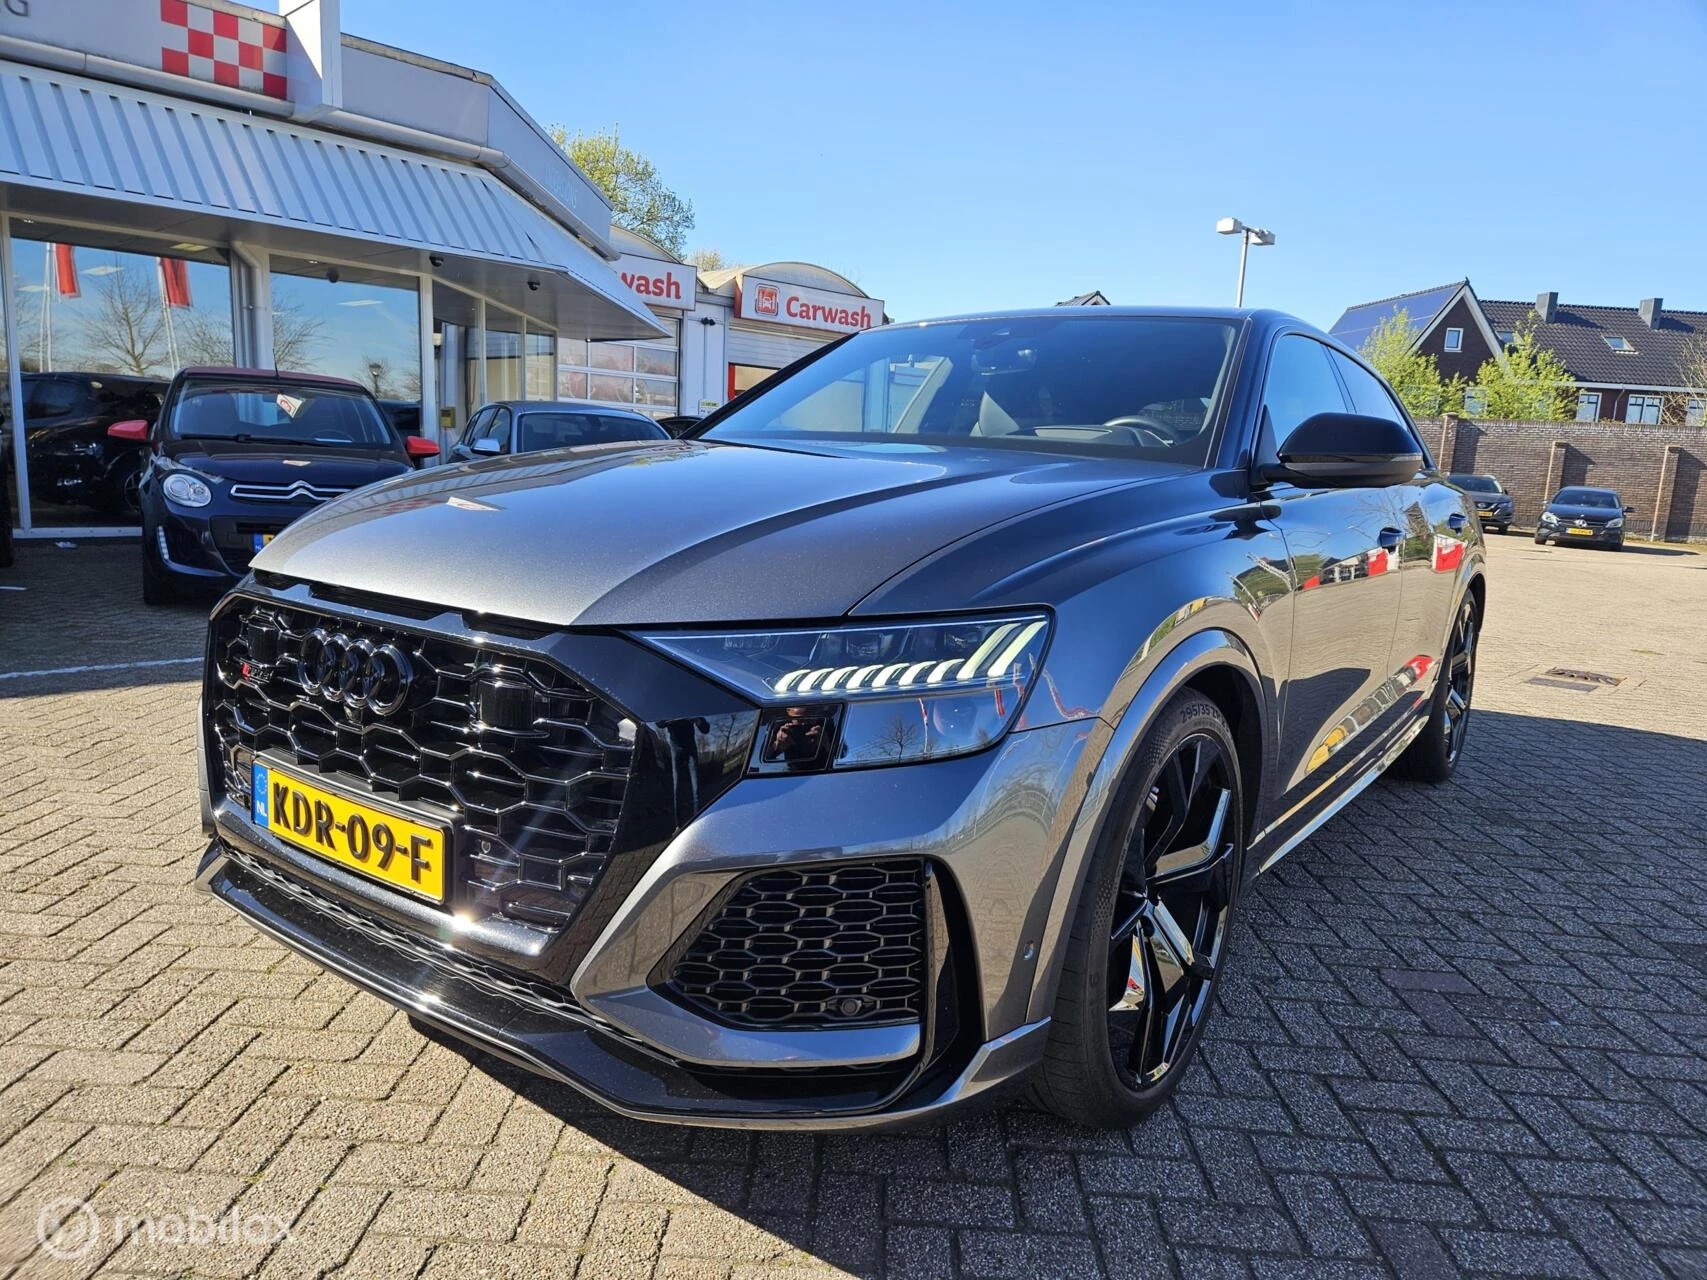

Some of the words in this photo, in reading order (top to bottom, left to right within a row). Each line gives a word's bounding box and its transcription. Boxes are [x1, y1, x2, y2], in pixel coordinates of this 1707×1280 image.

[786, 296, 872, 329] Carwash
[256, 803, 268, 818] NL
[272, 781, 433, 884] KDR-09-F
